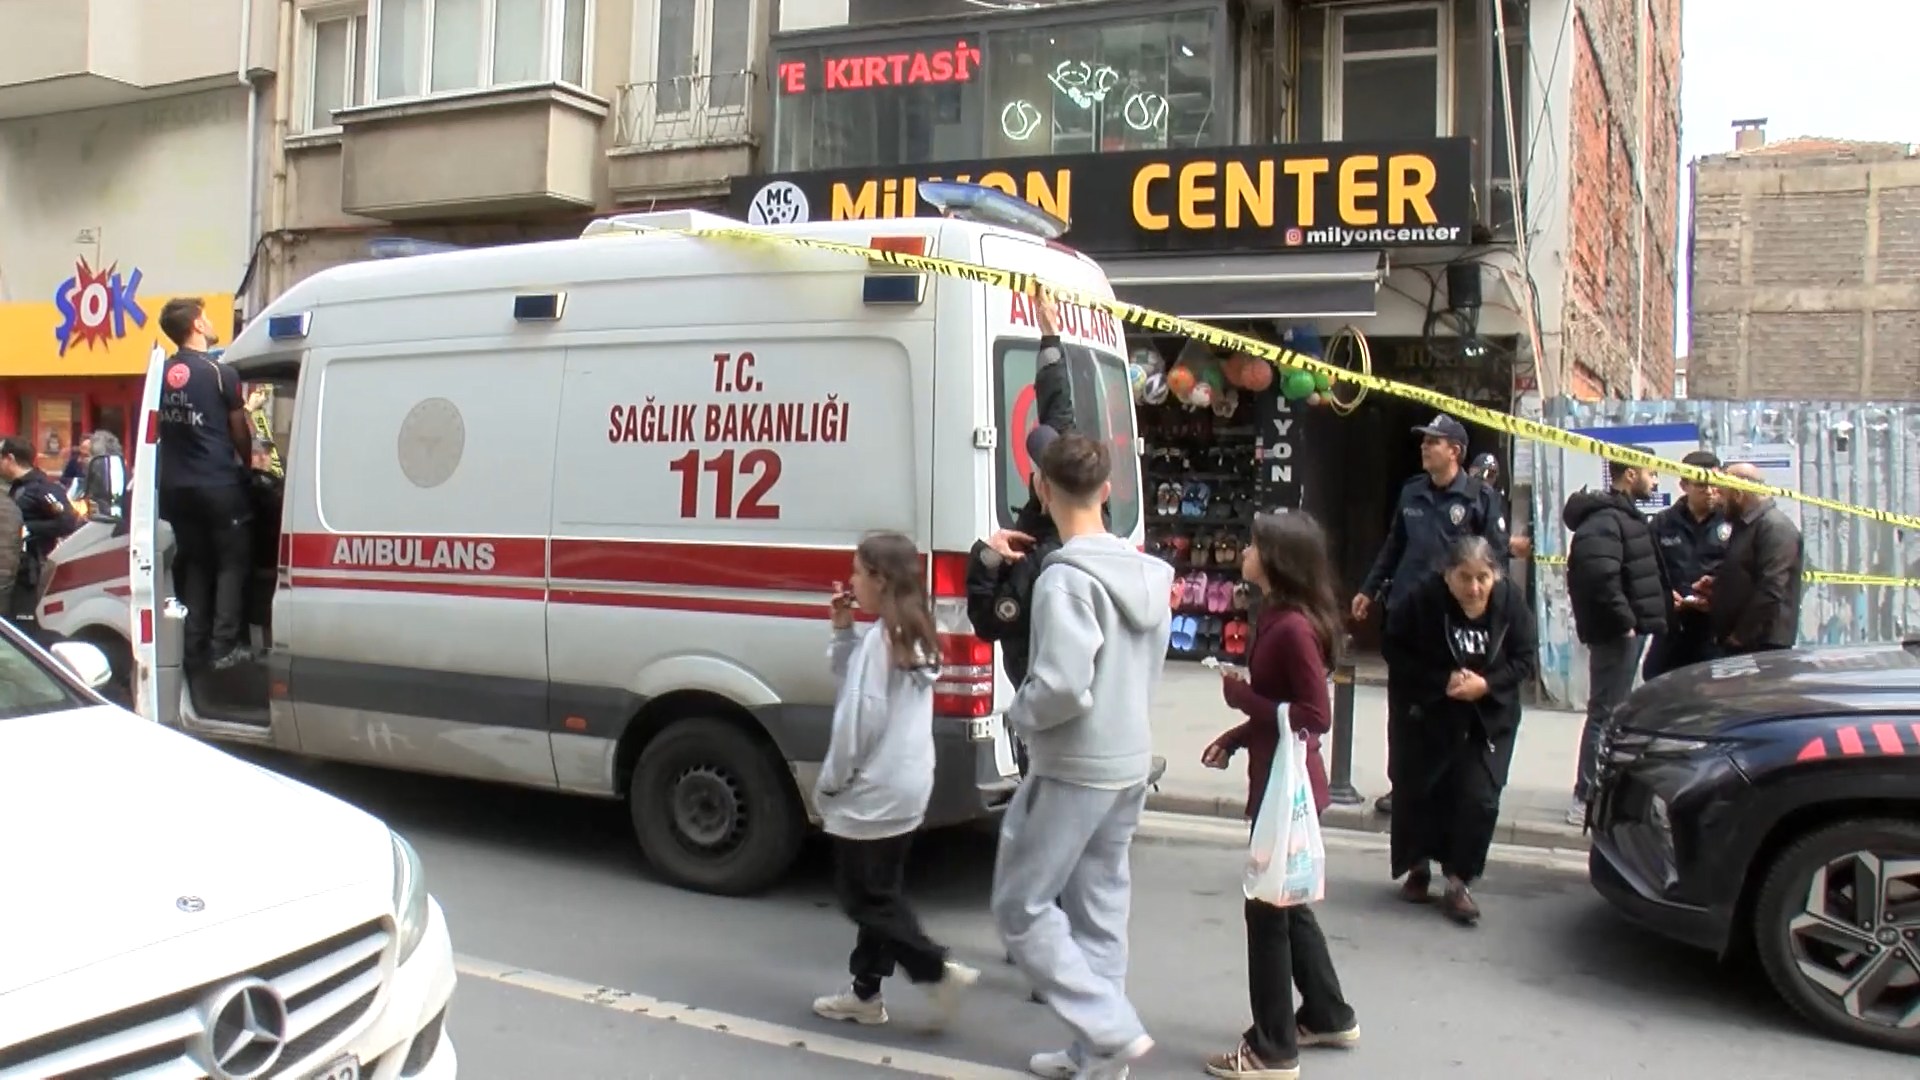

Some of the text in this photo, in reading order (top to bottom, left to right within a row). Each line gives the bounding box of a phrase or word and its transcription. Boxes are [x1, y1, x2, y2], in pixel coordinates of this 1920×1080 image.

[766, 188, 793, 206] MC
[1132, 154, 1438, 230] CENTER
[1306, 225, 1461, 246] milyoncenter
[714, 352, 763, 392] T.C.
[609, 392, 849, 443] SAĞLIK BAKANLIĞI
[669, 449, 783, 519] 112
[332, 536, 496, 571] AMBULANS
